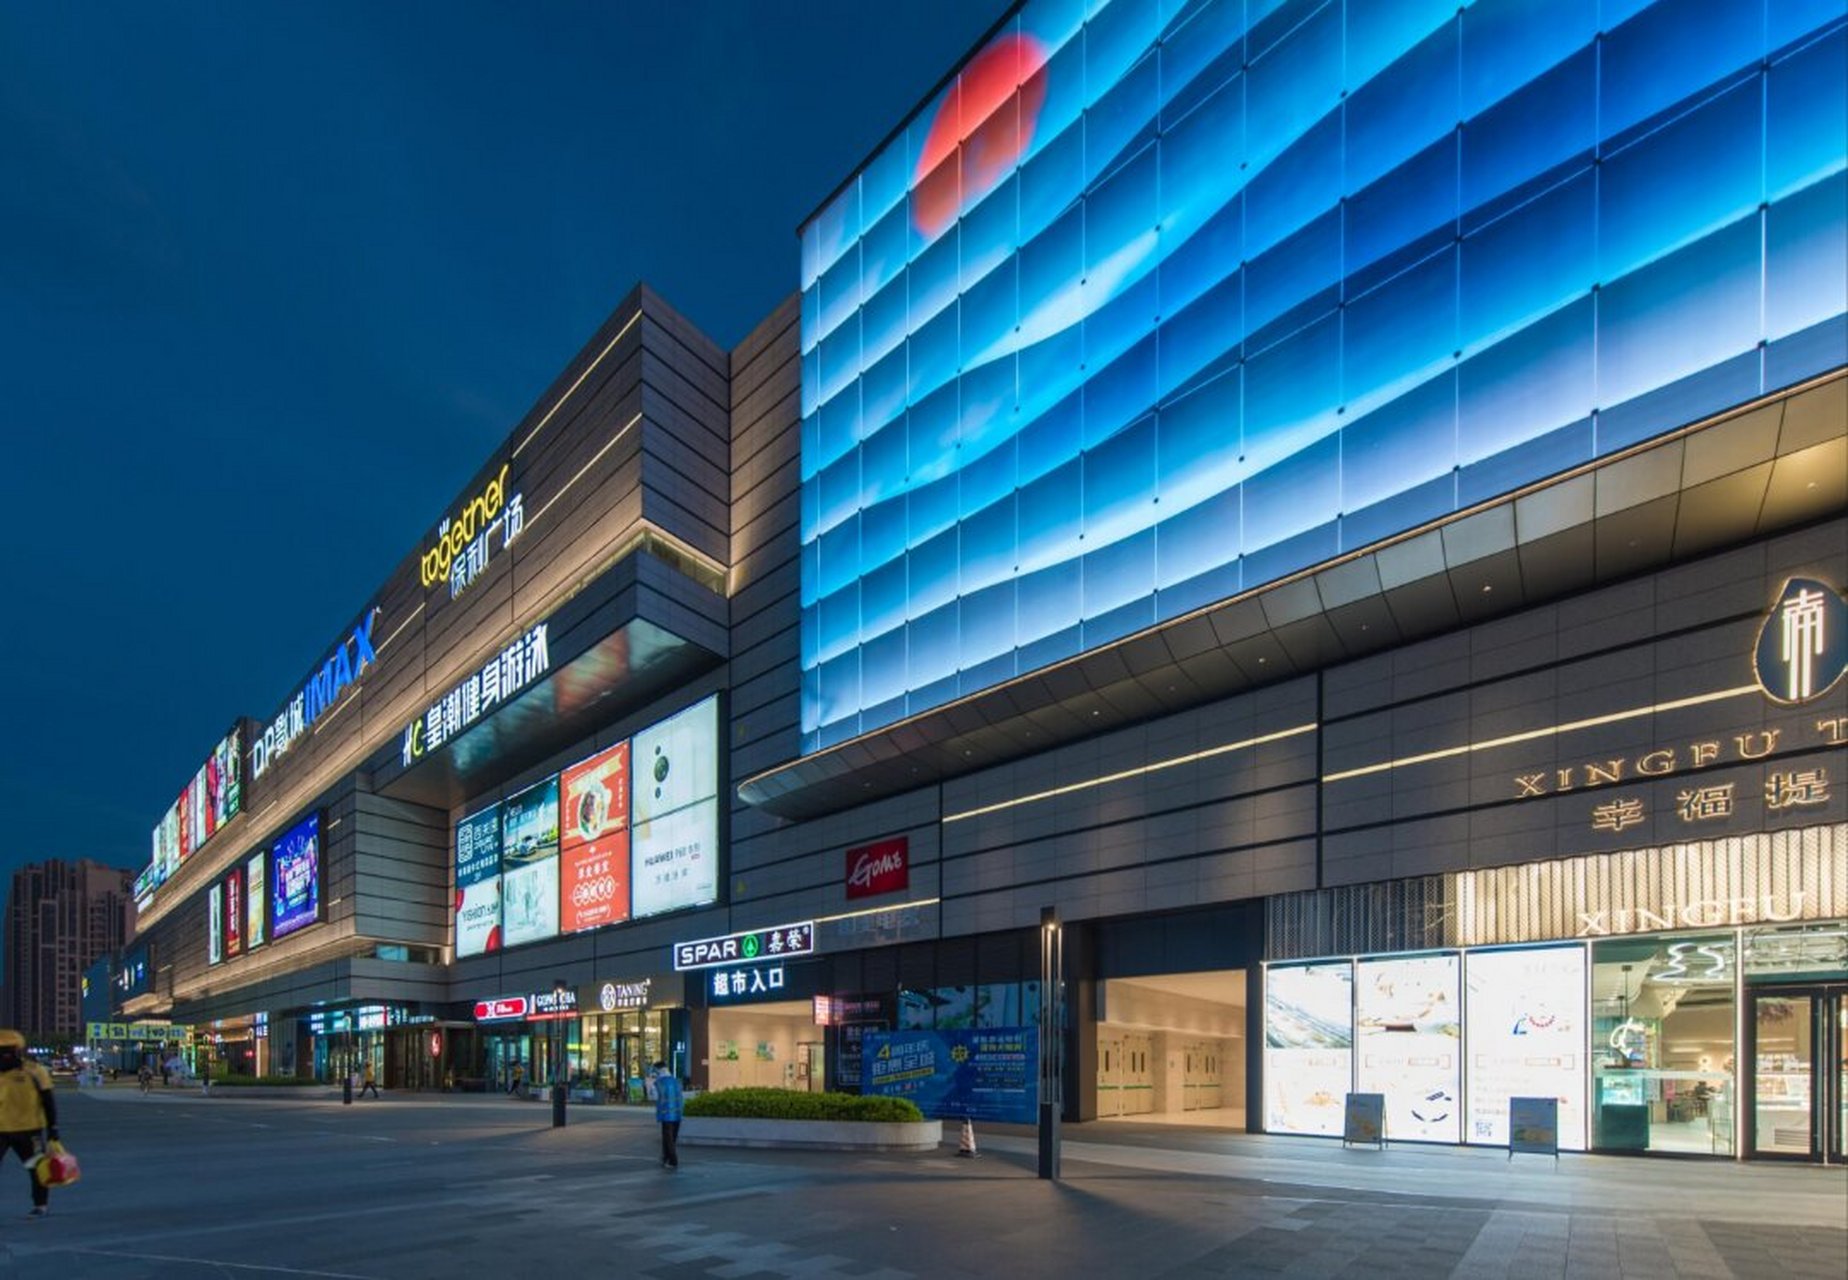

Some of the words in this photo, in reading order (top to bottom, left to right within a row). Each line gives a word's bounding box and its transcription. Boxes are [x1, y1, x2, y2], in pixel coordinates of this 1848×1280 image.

[451, 493, 523, 600] 保利广场
[304, 609, 376, 728] IMAX
[427, 624, 549, 752] 皇潮健身游泳
[1515, 729, 1780, 799] XINGFU
[1576, 891, 1806, 937] XINGFU
[681, 940, 736, 965] SPAR
[714, 968, 783, 996] 超市入口
